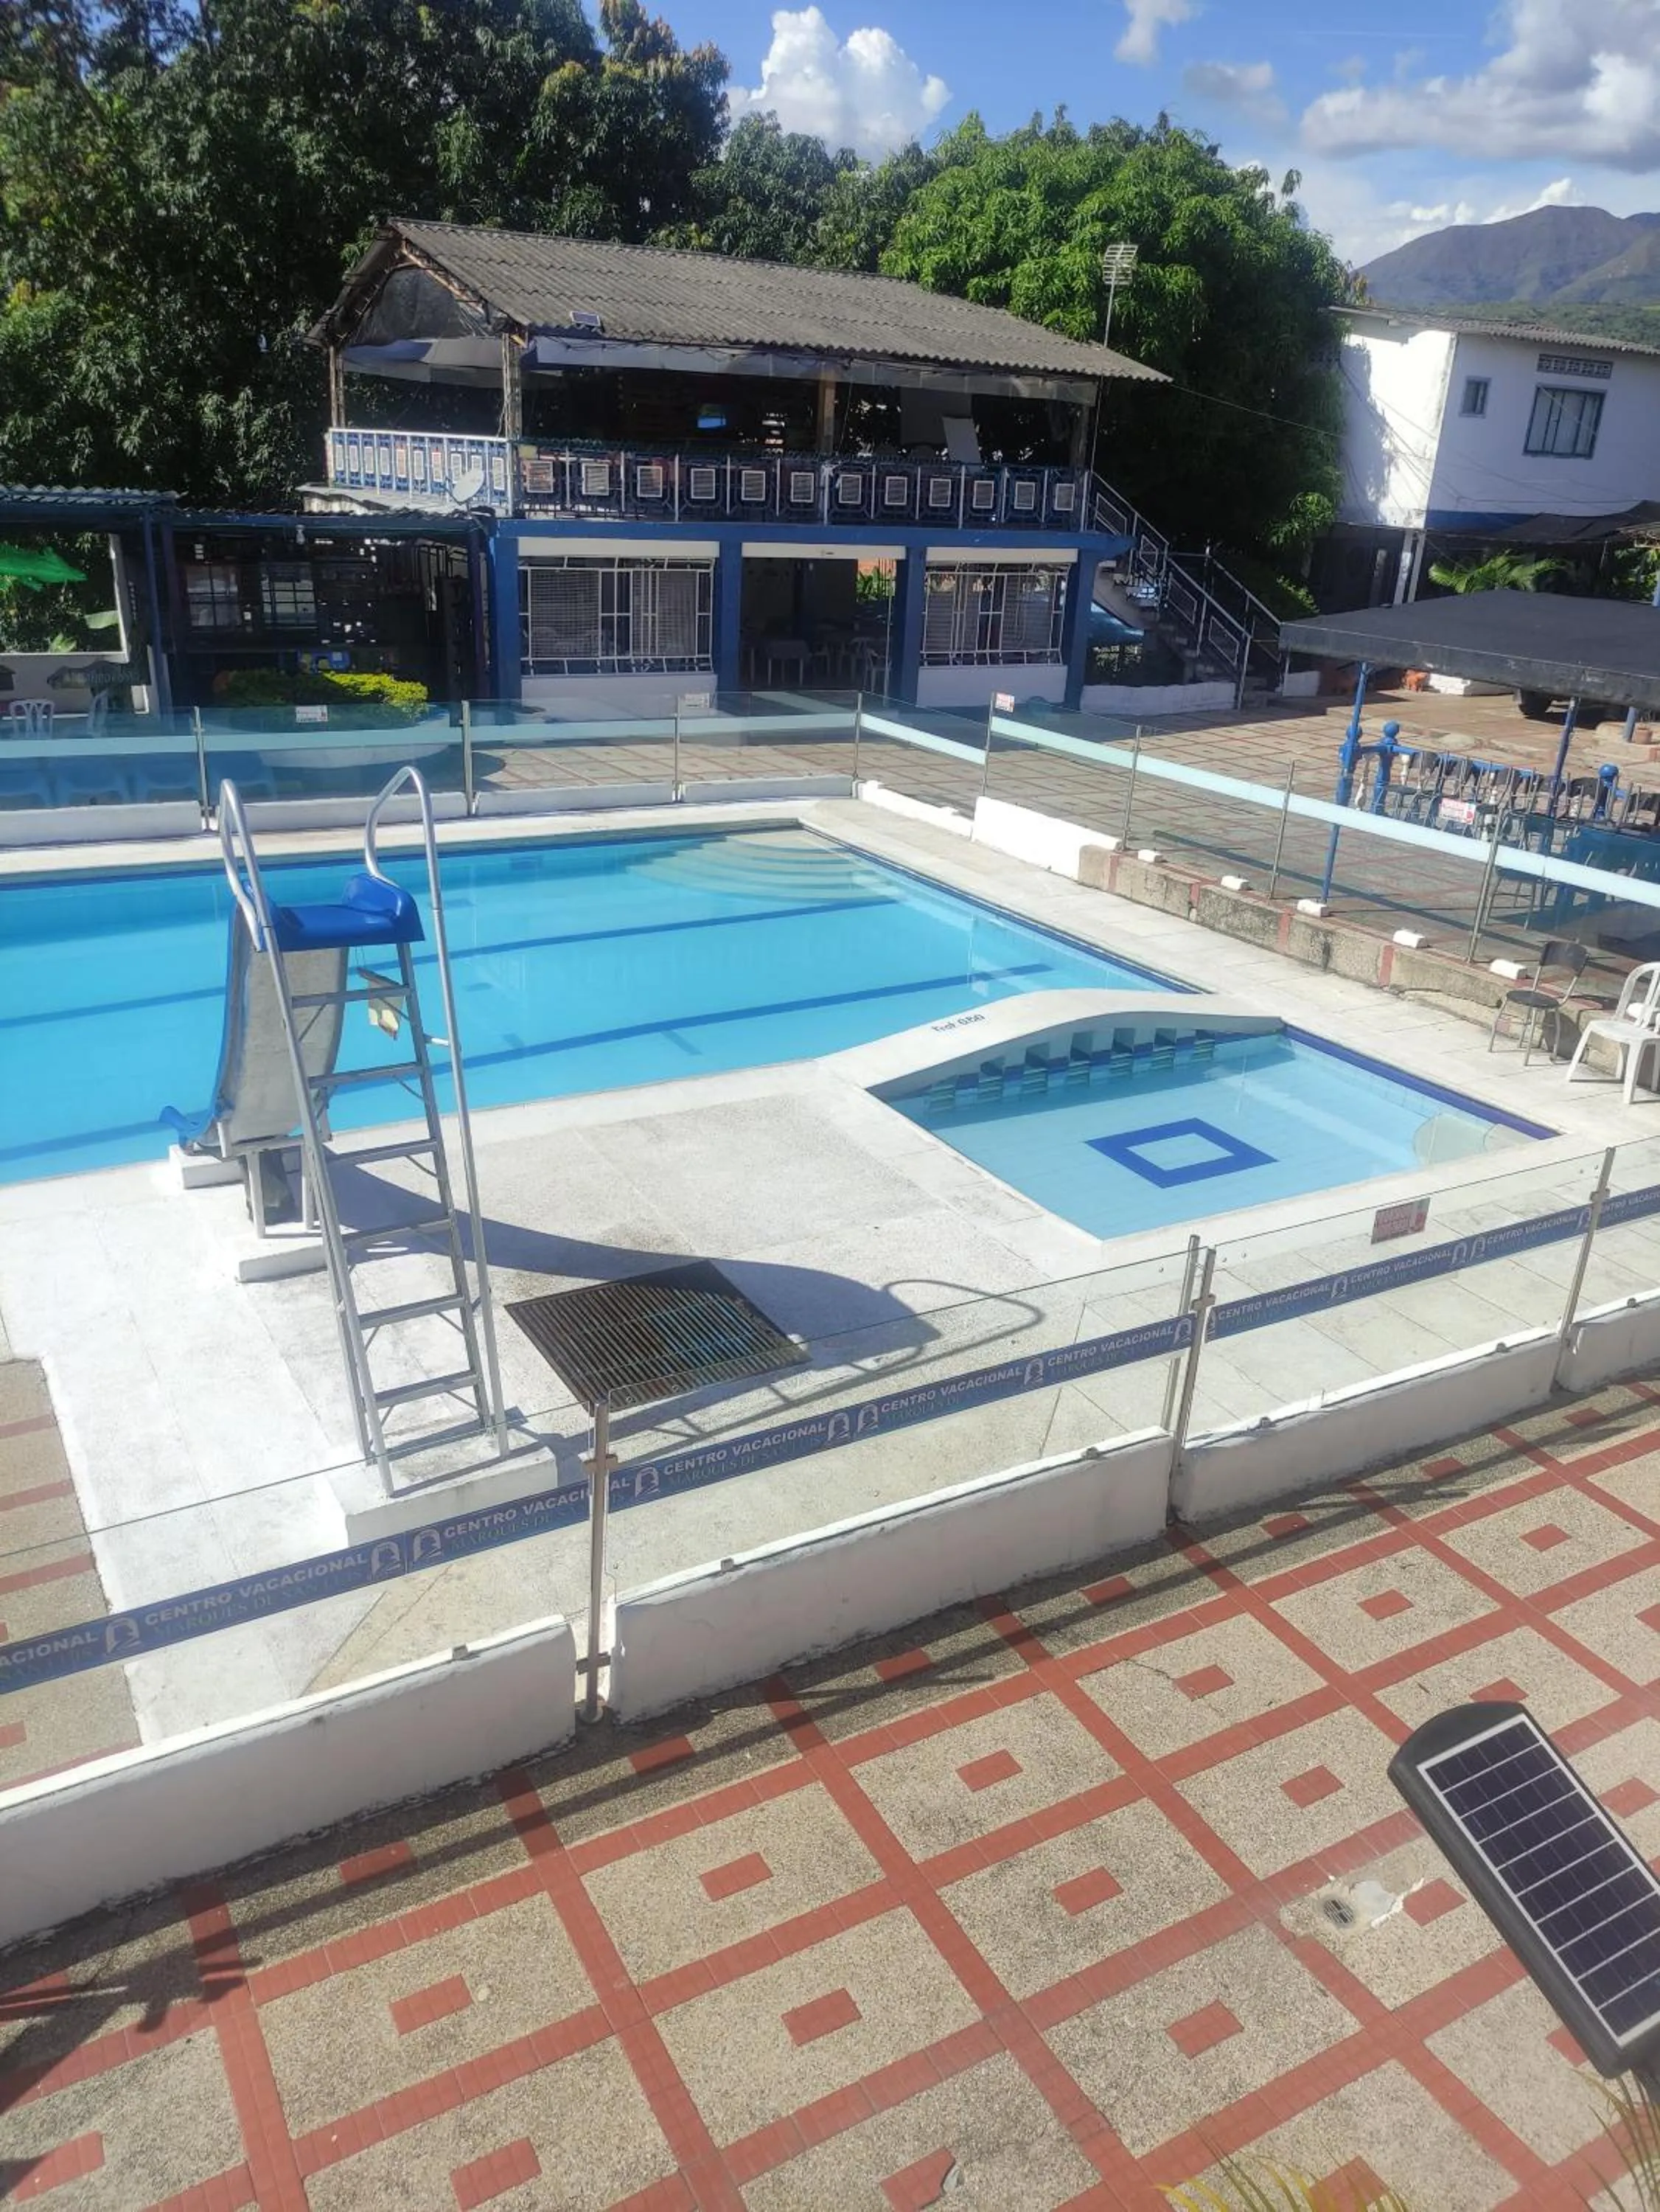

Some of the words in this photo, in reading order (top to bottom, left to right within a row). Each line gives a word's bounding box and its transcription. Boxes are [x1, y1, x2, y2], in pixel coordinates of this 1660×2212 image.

[1218, 1301, 1263, 1321] CENTRO
[1266, 1284, 1330, 1308] VACACIONAL
[1047, 1346, 1097, 1366] CENTRO
[1101, 1326, 1173, 1353] VACACIONAL
[881, 1390, 935, 1413] CENTRO
[941, 1366, 1023, 1396] VACACIONAL
[664, 1450, 728, 1475] CENTRO
[732, 1422, 826, 1458] VACACIONAL
[444, 1509, 517, 1539] CENTRO
[144, 1593, 232, 1626] CENTRO
[240, 1553, 368, 1598] VACACIONAL
